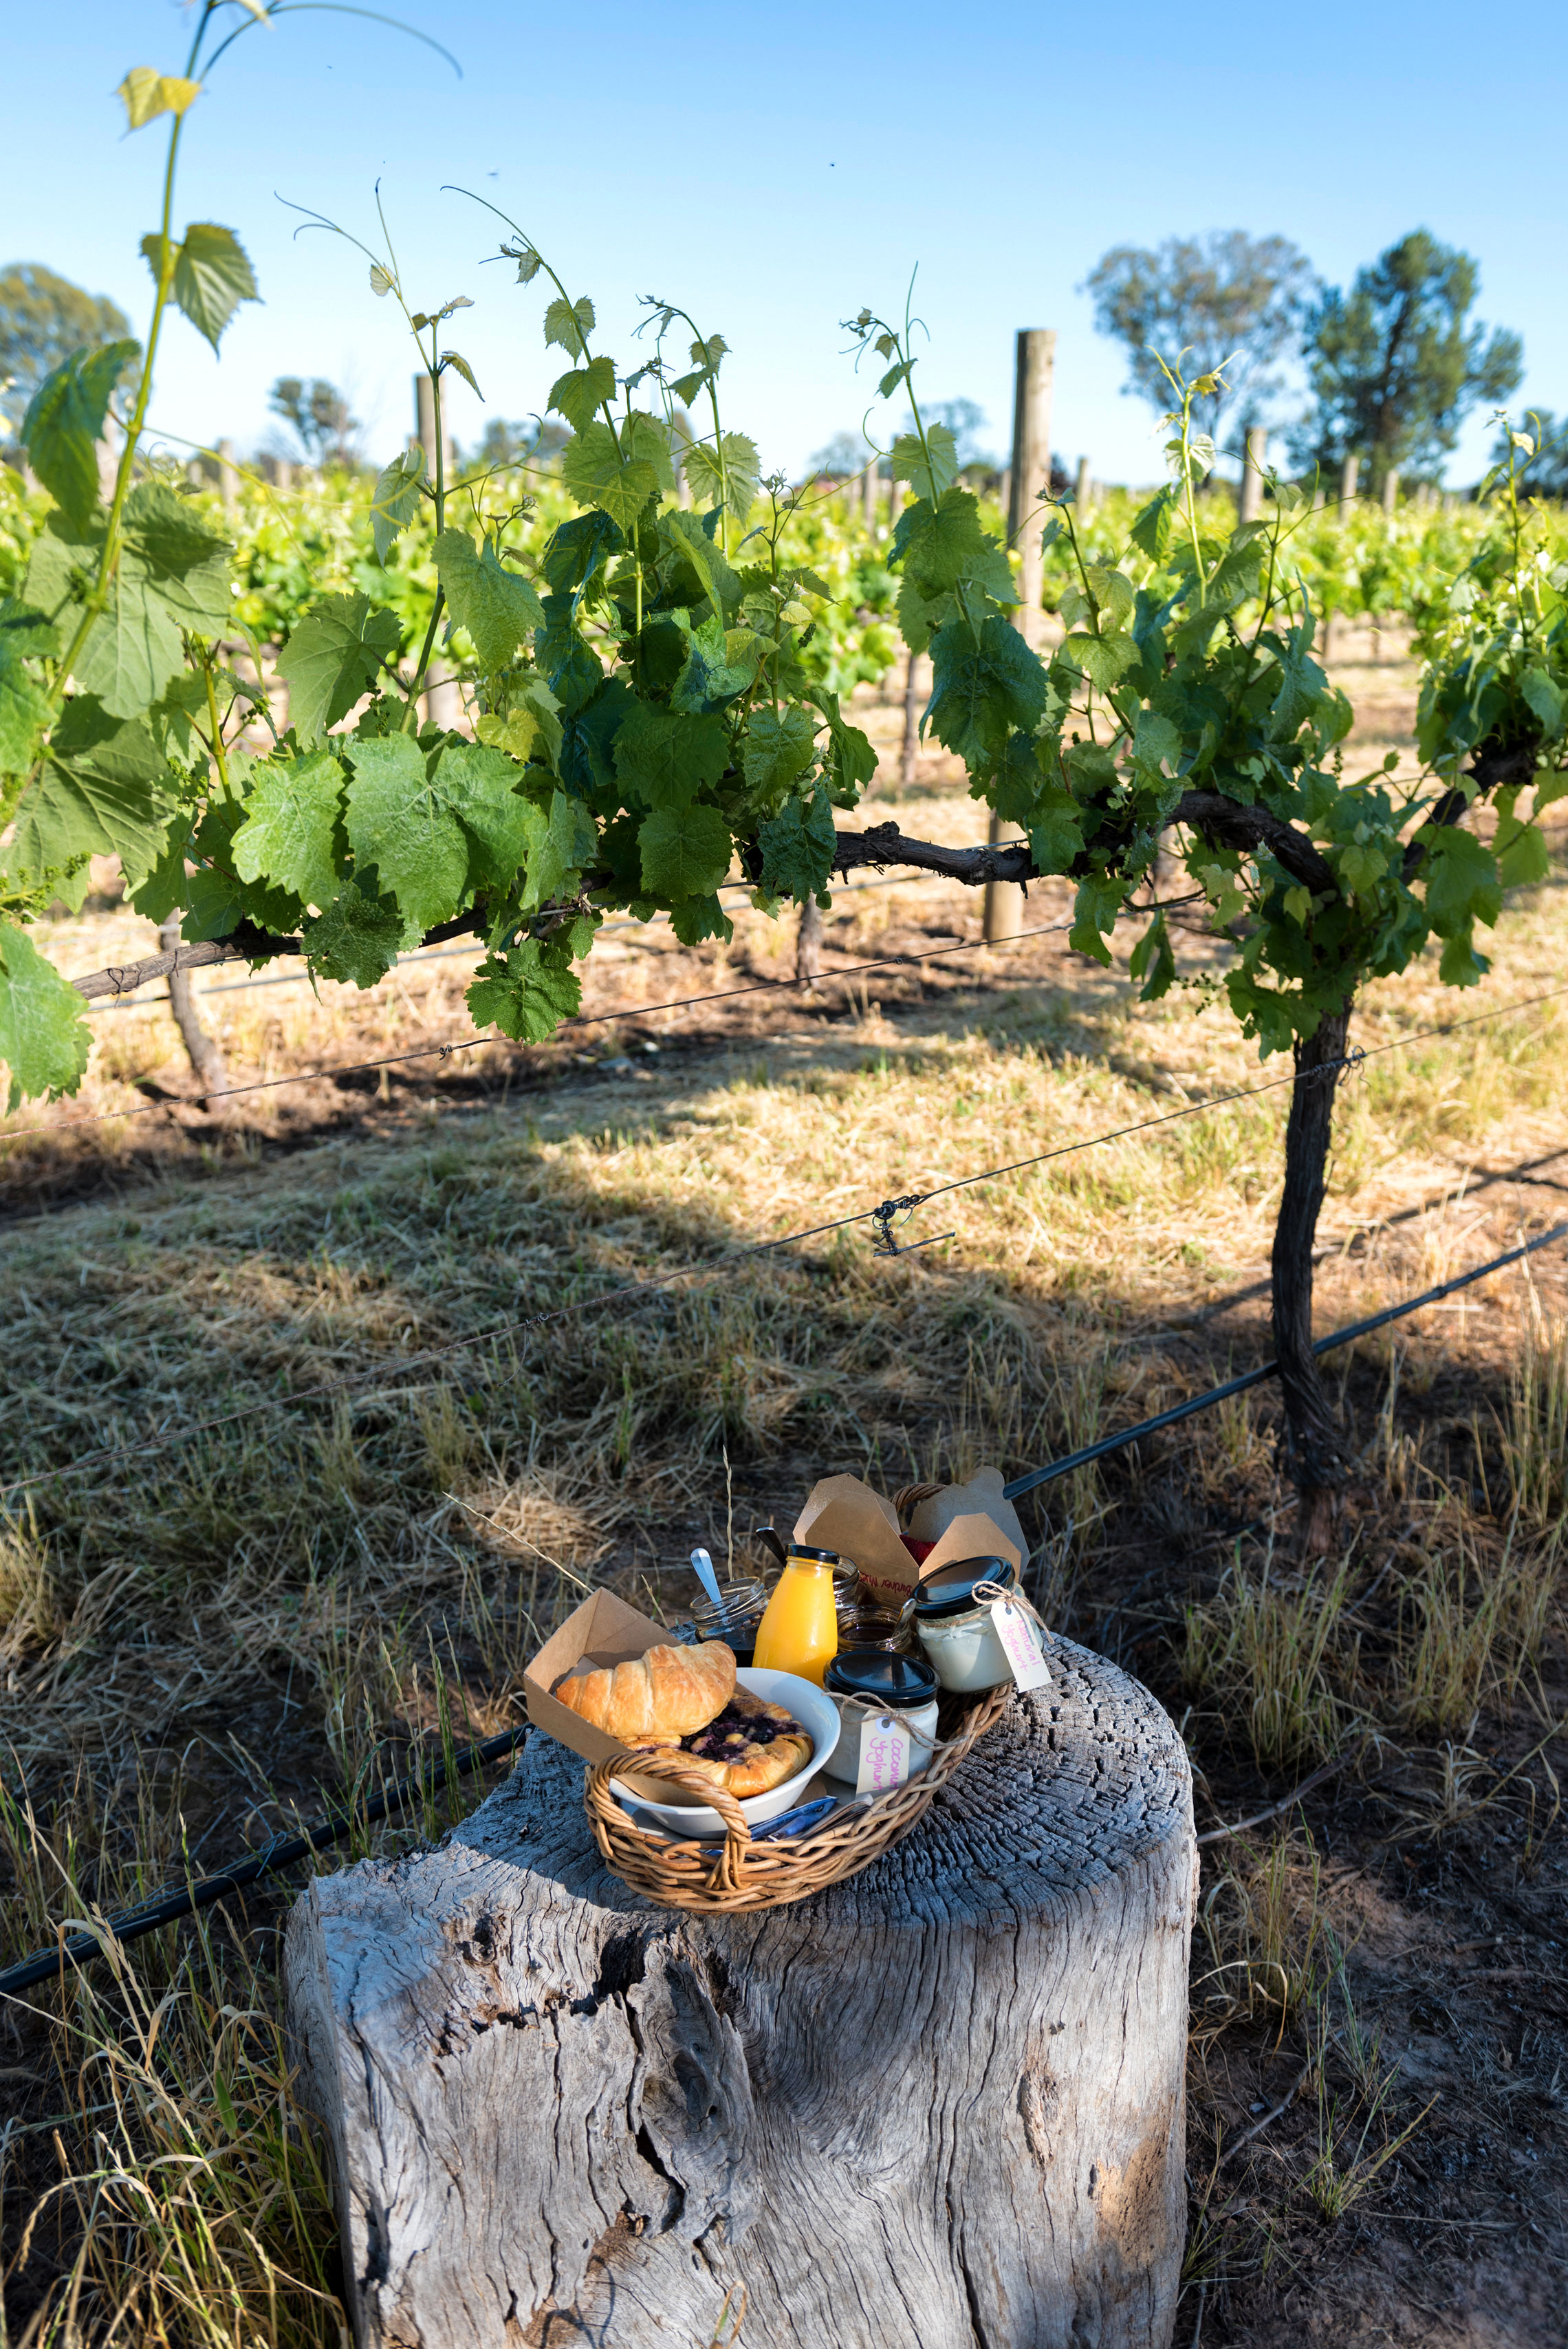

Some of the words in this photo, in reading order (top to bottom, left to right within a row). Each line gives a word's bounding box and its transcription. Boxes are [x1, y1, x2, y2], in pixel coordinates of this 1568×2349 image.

[881, 1579, 913, 1597] Bircher
[1016, 1619, 1041, 1666] Natural
[890, 1738, 904, 1790] Coconut
